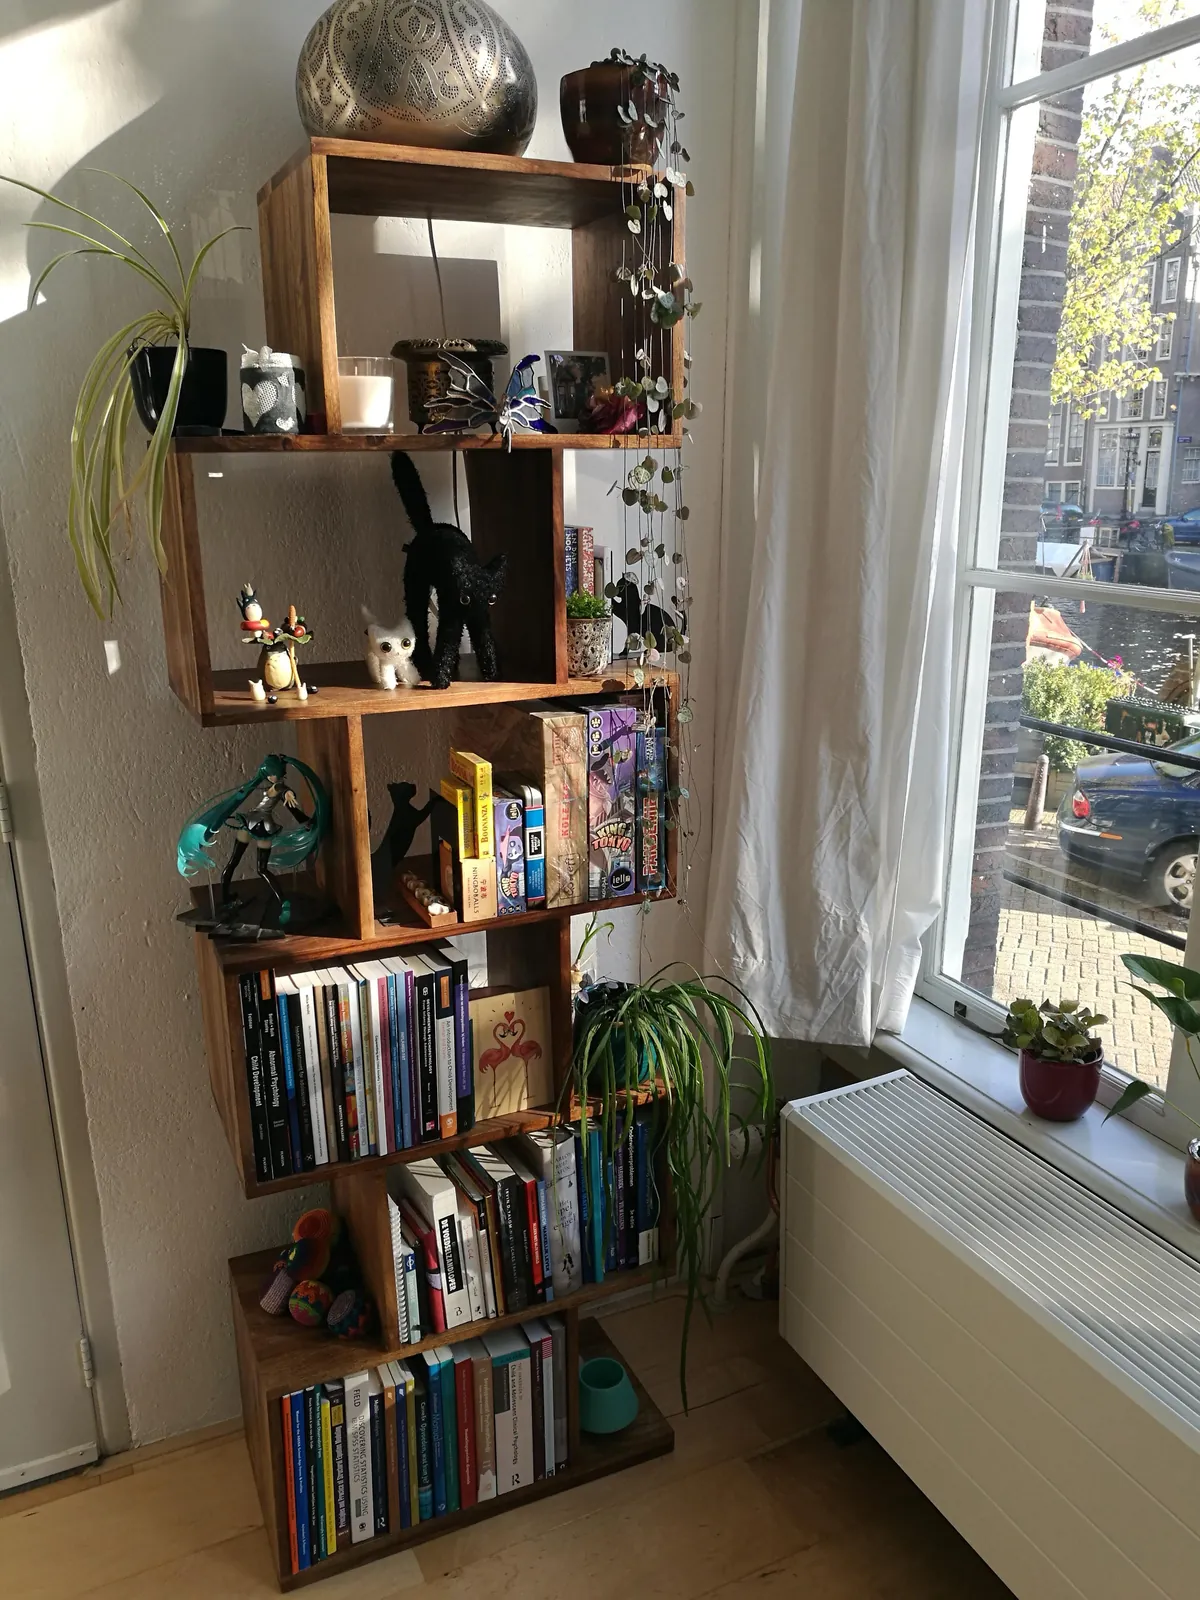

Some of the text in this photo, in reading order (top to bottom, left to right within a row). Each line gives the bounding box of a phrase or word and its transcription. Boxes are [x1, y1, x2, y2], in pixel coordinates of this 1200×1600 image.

[591, 835, 632, 852] TOKYO
[596, 822, 627, 839] KING
[472, 866, 480, 915] NINGBOBALLS
[250, 1055, 263, 1108] Child Development
[268, 1050, 282, 1108] Abnormal Psychology
[447, 1078, 455, 1112] Development
[541, 1226, 549, 1254] MAKKELIJK
[440, 1219, 457, 1292] DE VOEDSELZANDLOPER
[543, 1254, 551, 1273] LEVEN
[353, 1388, 362, 1408] FIELD
[511, 1388, 519, 1417] Adolescent
[351, 1431, 360, 1447] SPSS
[432, 1413, 442, 1442] Manual
[511, 1436, 519, 1465] Psychology
[352, 1448, 361, 1484] STATISTICS
[357, 1415, 370, 1517] DISCOVERING STATISTICS USING
